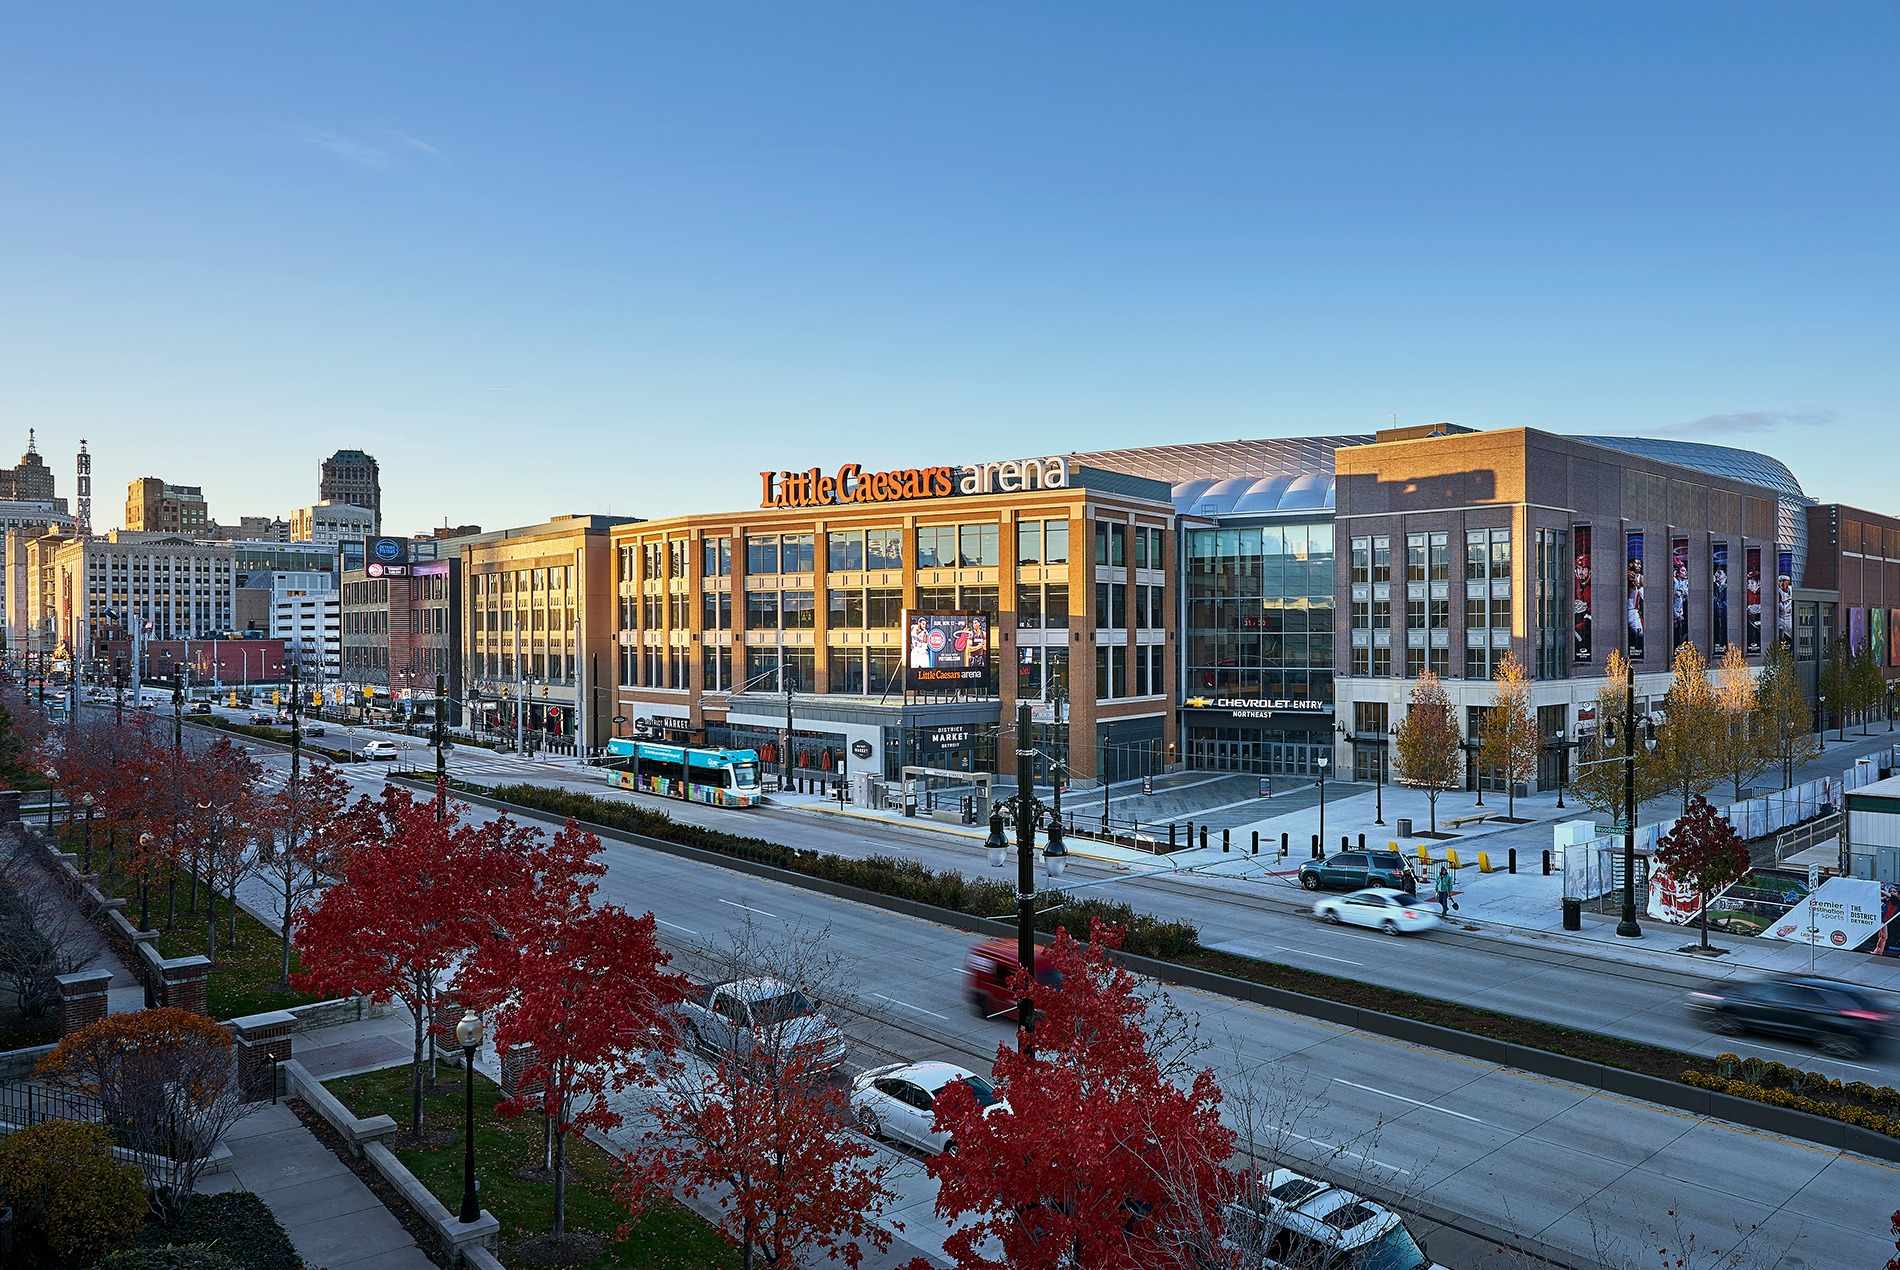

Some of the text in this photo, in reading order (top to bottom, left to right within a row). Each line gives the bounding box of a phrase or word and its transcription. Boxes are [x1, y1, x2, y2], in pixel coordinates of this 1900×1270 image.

[760, 456, 1069, 508] Little Caesars arena
[918, 671, 936, 680] Little
[936, 670, 960, 680] Caesars
[1218, 698, 1324, 709] CHEVROLET ENTRY
[664, 718, 688, 728] MARKET
[932, 732, 968, 742] MARKET
[1810, 878, 1817, 889] 30
[1851, 912, 1877, 921] DISTRICT
